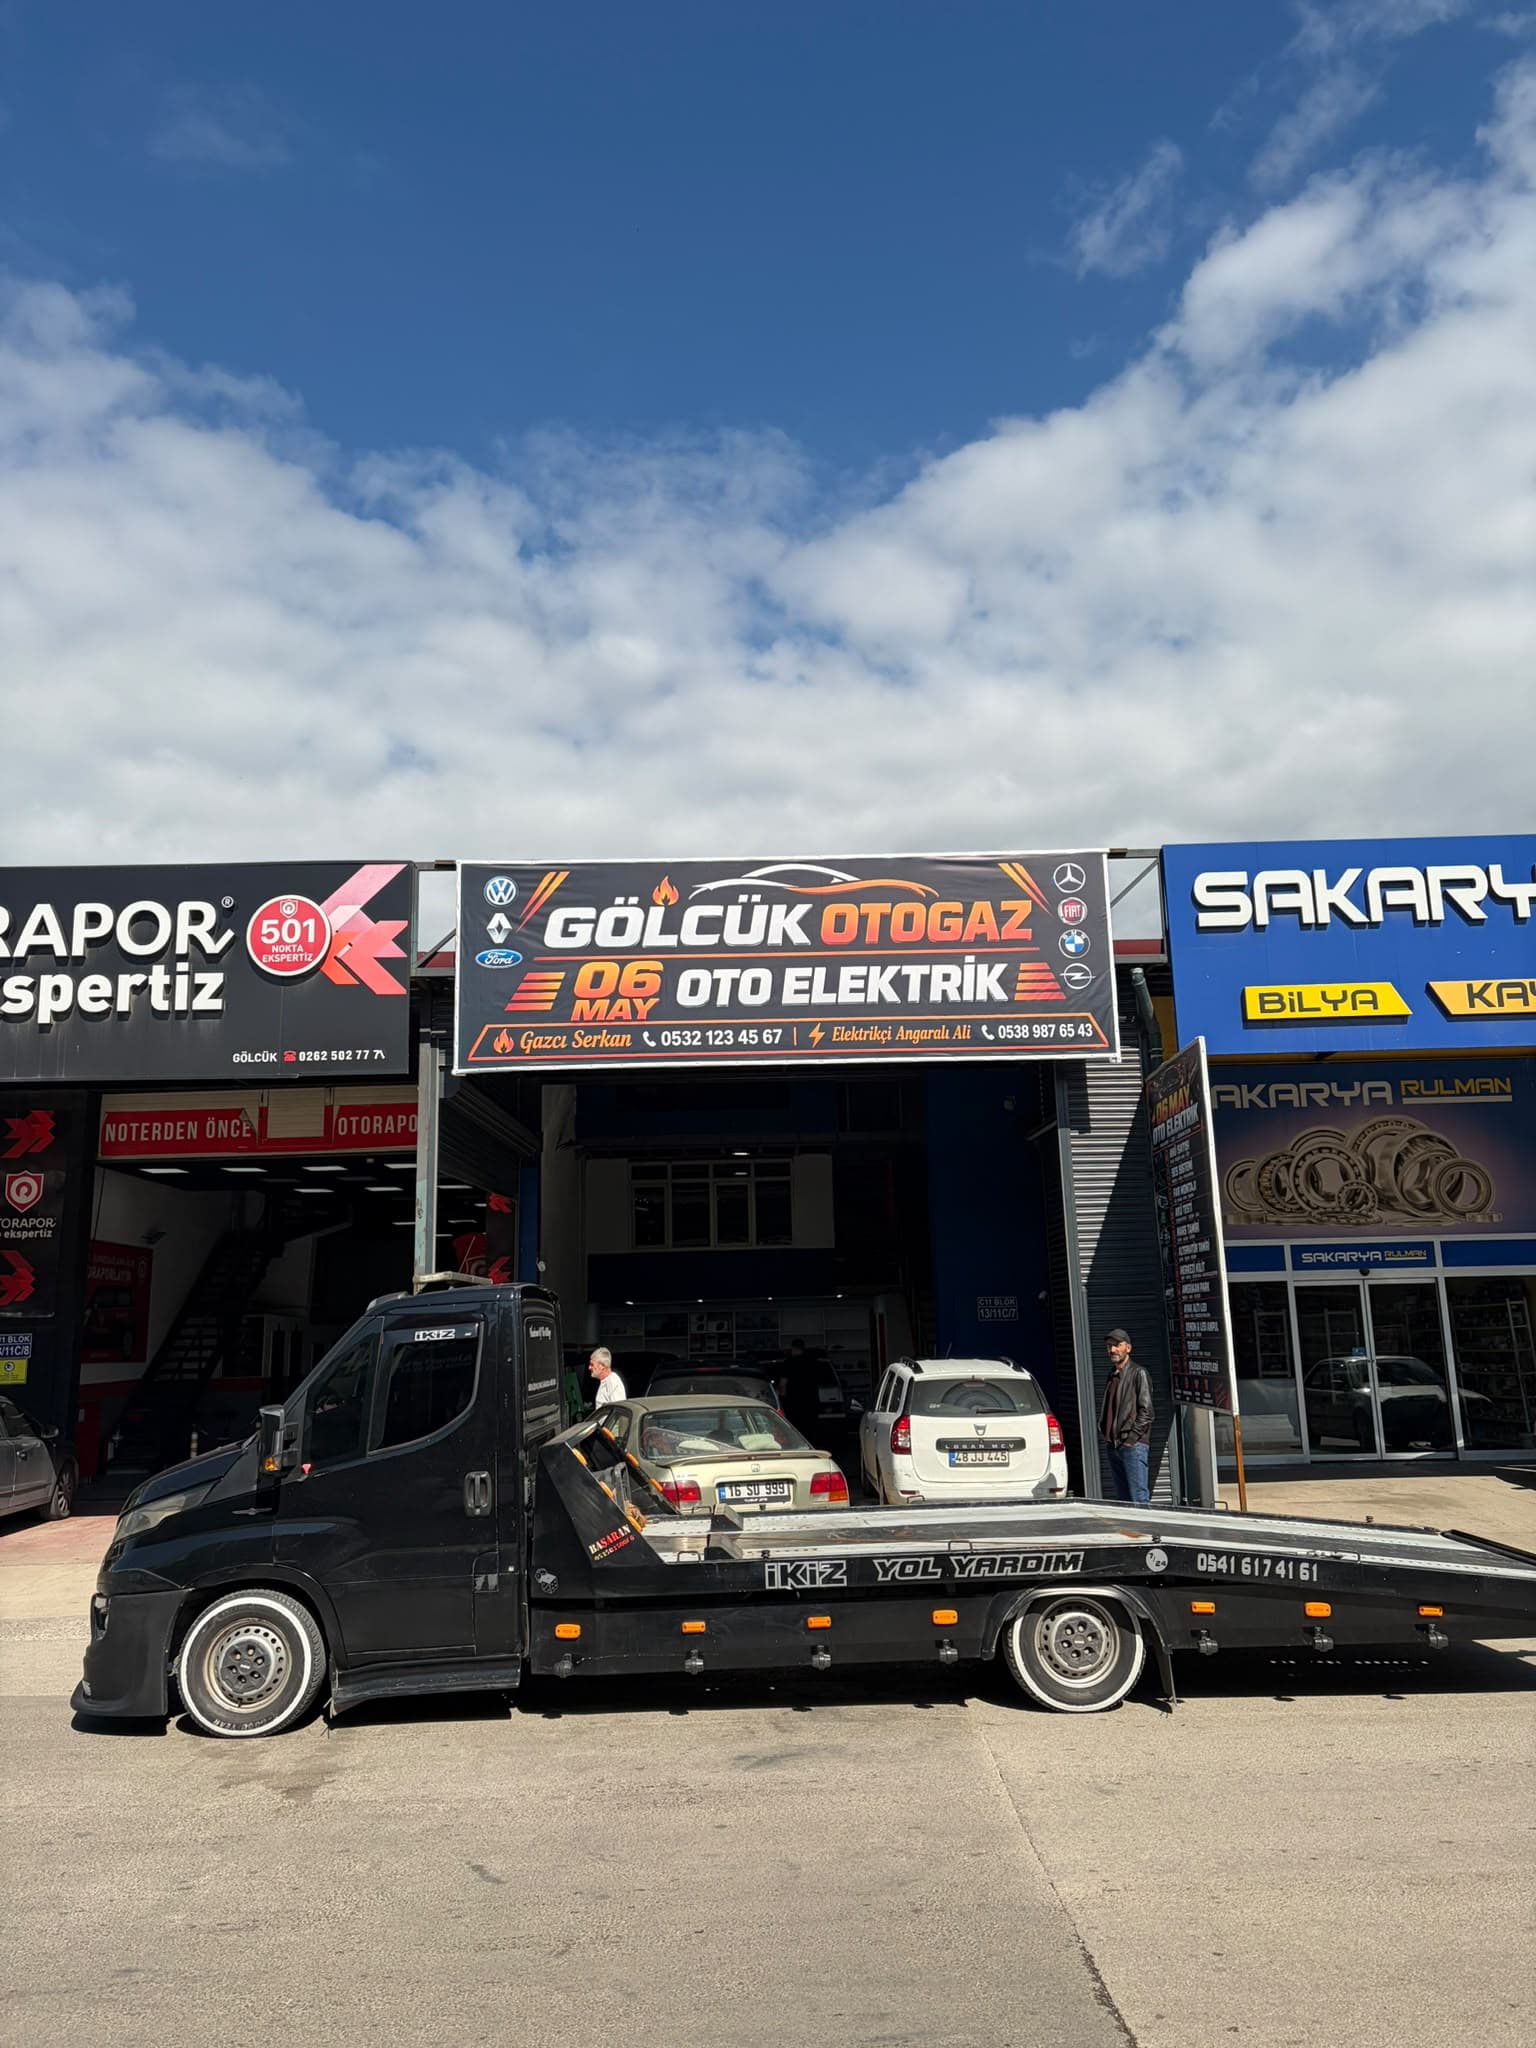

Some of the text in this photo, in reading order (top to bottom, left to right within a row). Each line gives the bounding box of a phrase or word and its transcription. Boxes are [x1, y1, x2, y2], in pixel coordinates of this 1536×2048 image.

[543, 894, 1032, 949] GÖLCÜK OTOGAZ
[1063, 904, 1082, 918] FIAT
[0, 900, 234, 958] APOR
[260, 918, 316, 945] 501
[262, 952, 313, 963] EKSPERTİZ
[271, 944, 304, 954] NOKTA
[573, 961, 664, 998] 06
[676, 955, 1008, 1007] OTO ELEKTRİK
[0, 962, 223, 1024] spertiz
[570, 998, 660, 1022] MAY
[519, 1028, 782, 1053] Gazcı Serkan 0532 123 45 67
[831, 1021, 1093, 1046] Elektrikçi Angaralı Ali 0538 987 65 43
[233, 1051, 278, 1063] GÖLCÜK
[299, 1050, 326, 1062] 0262
[331, 1050, 352, 1061] 502
[355, 1050, 370, 1060] 77
[1212, 1078, 1511, 1109] AKARYA RULMAN
[105, 1117, 252, 1143] NOTERDEN ÖNCE
[4, 1229, 53, 1240] ekspertiz
[1302, 1250, 1427, 1263] SAKARYA RULMAN
[955, 1452, 969, 1462] 48
[987, 1451, 1007, 1461] 445
[729, 1484, 741, 1497] 16
[765, 1481, 785, 1494] 999
[873, 1558, 942, 1581] YOL
[950, 1552, 1084, 1578] YARDIM
[1197, 1553, 1318, 1582] 0541 617 41 61
